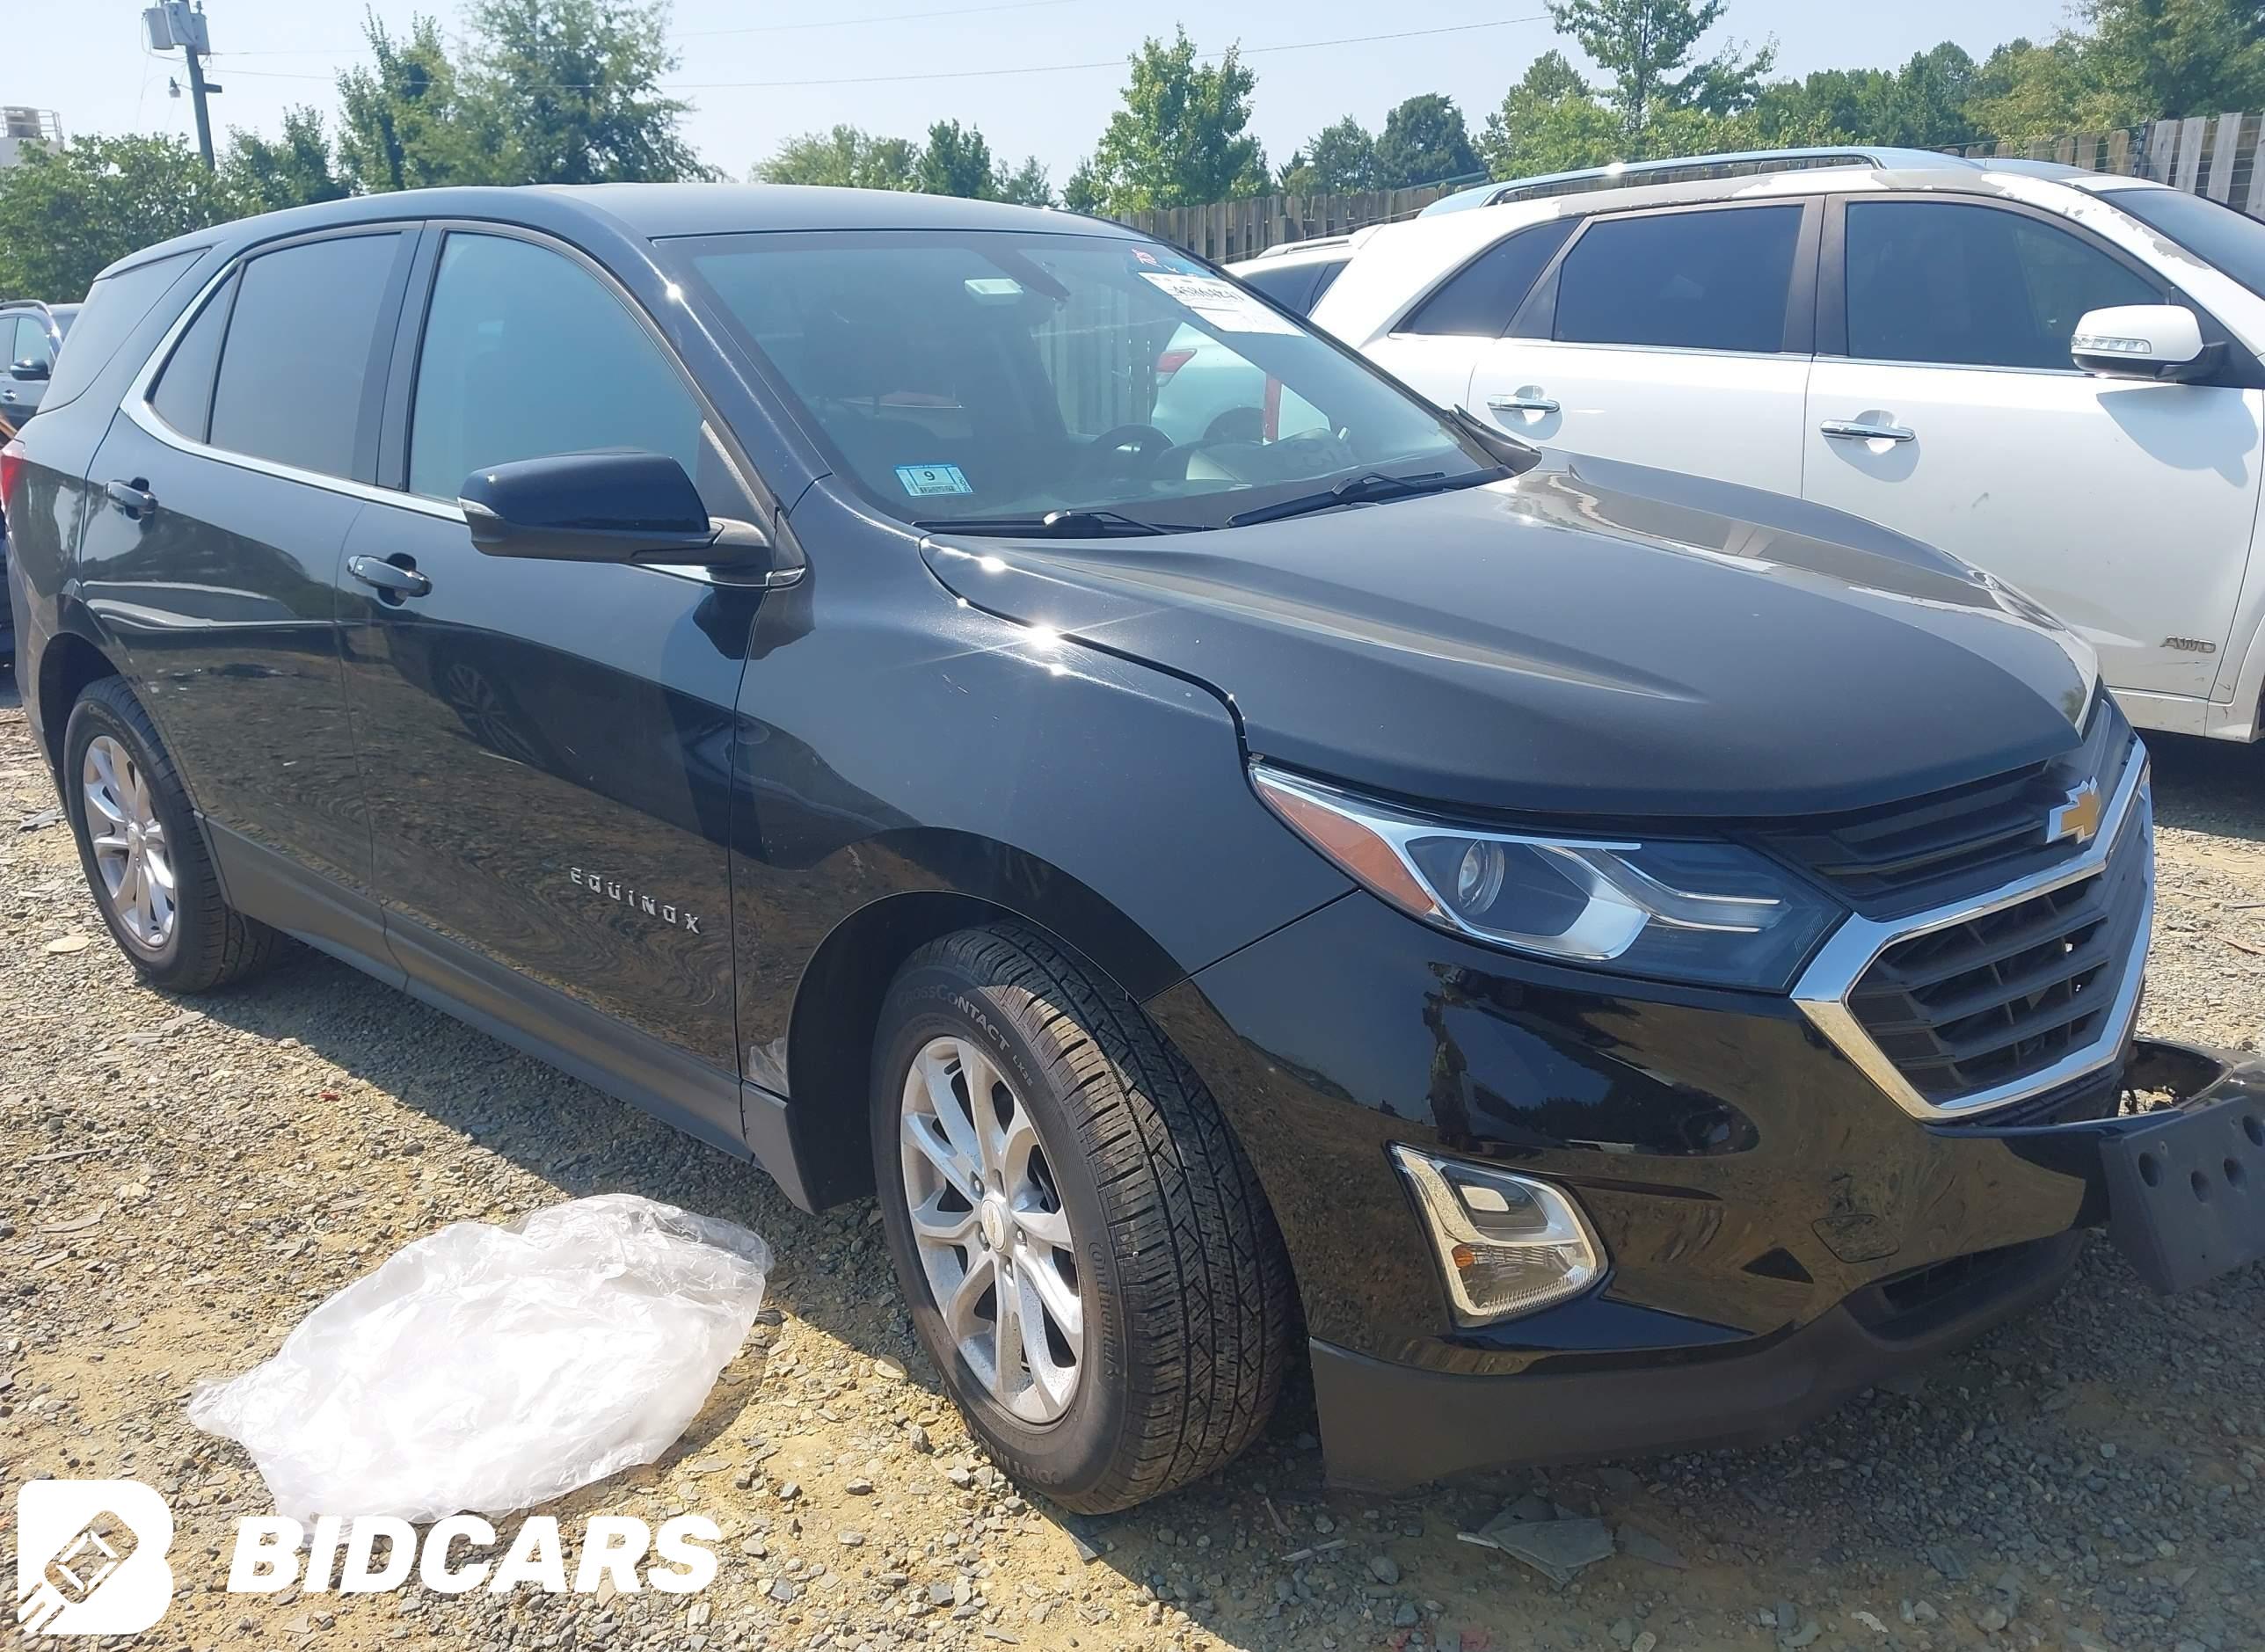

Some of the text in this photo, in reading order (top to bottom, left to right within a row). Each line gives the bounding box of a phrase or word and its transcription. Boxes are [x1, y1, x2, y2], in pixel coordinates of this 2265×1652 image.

[923, 470, 936, 481] 9
[2159, 635, 2216, 653] AWD
[571, 867, 701, 935] EQUINOX
